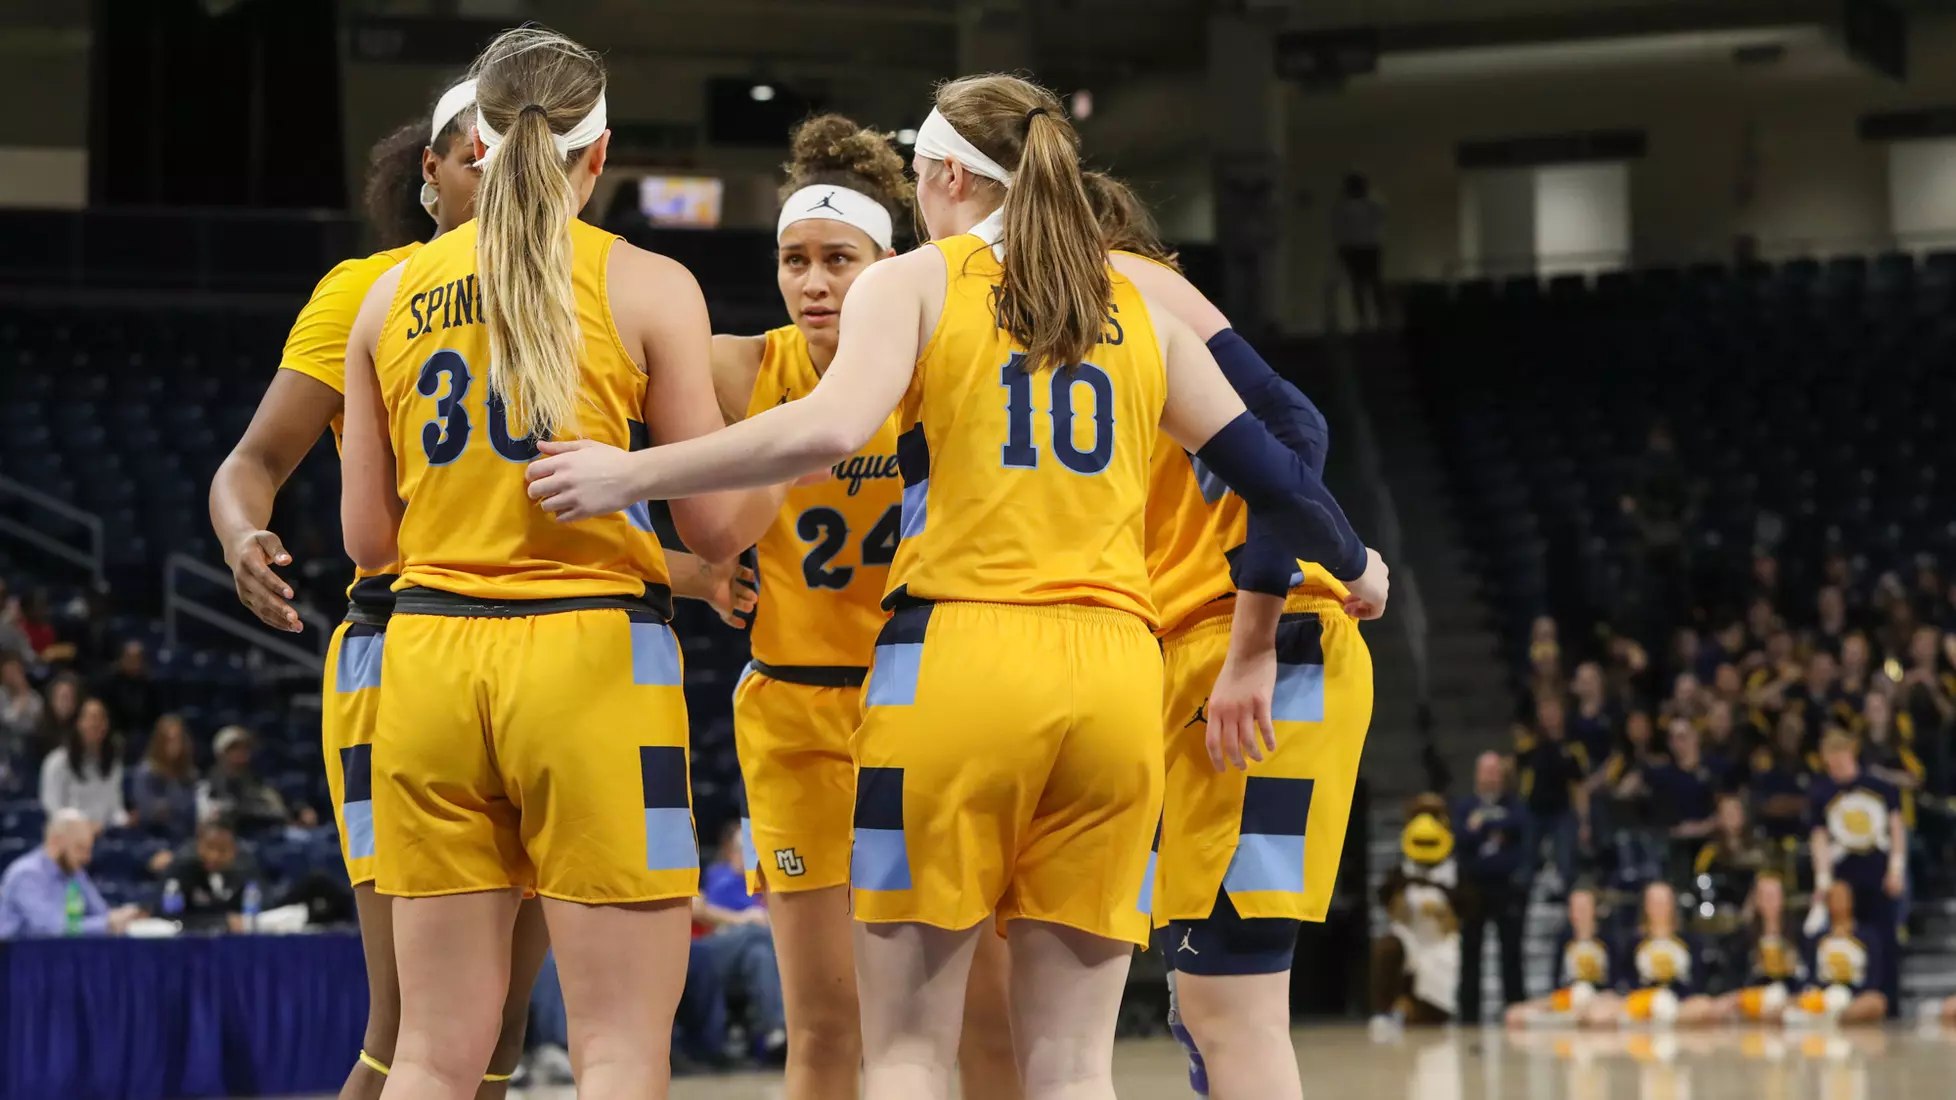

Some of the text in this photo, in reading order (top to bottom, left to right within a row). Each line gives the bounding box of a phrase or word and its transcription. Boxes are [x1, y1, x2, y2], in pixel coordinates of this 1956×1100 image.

[1000, 351, 1117, 477] 10
[796, 503, 902, 591] 24
[774, 847, 806, 877] MU
